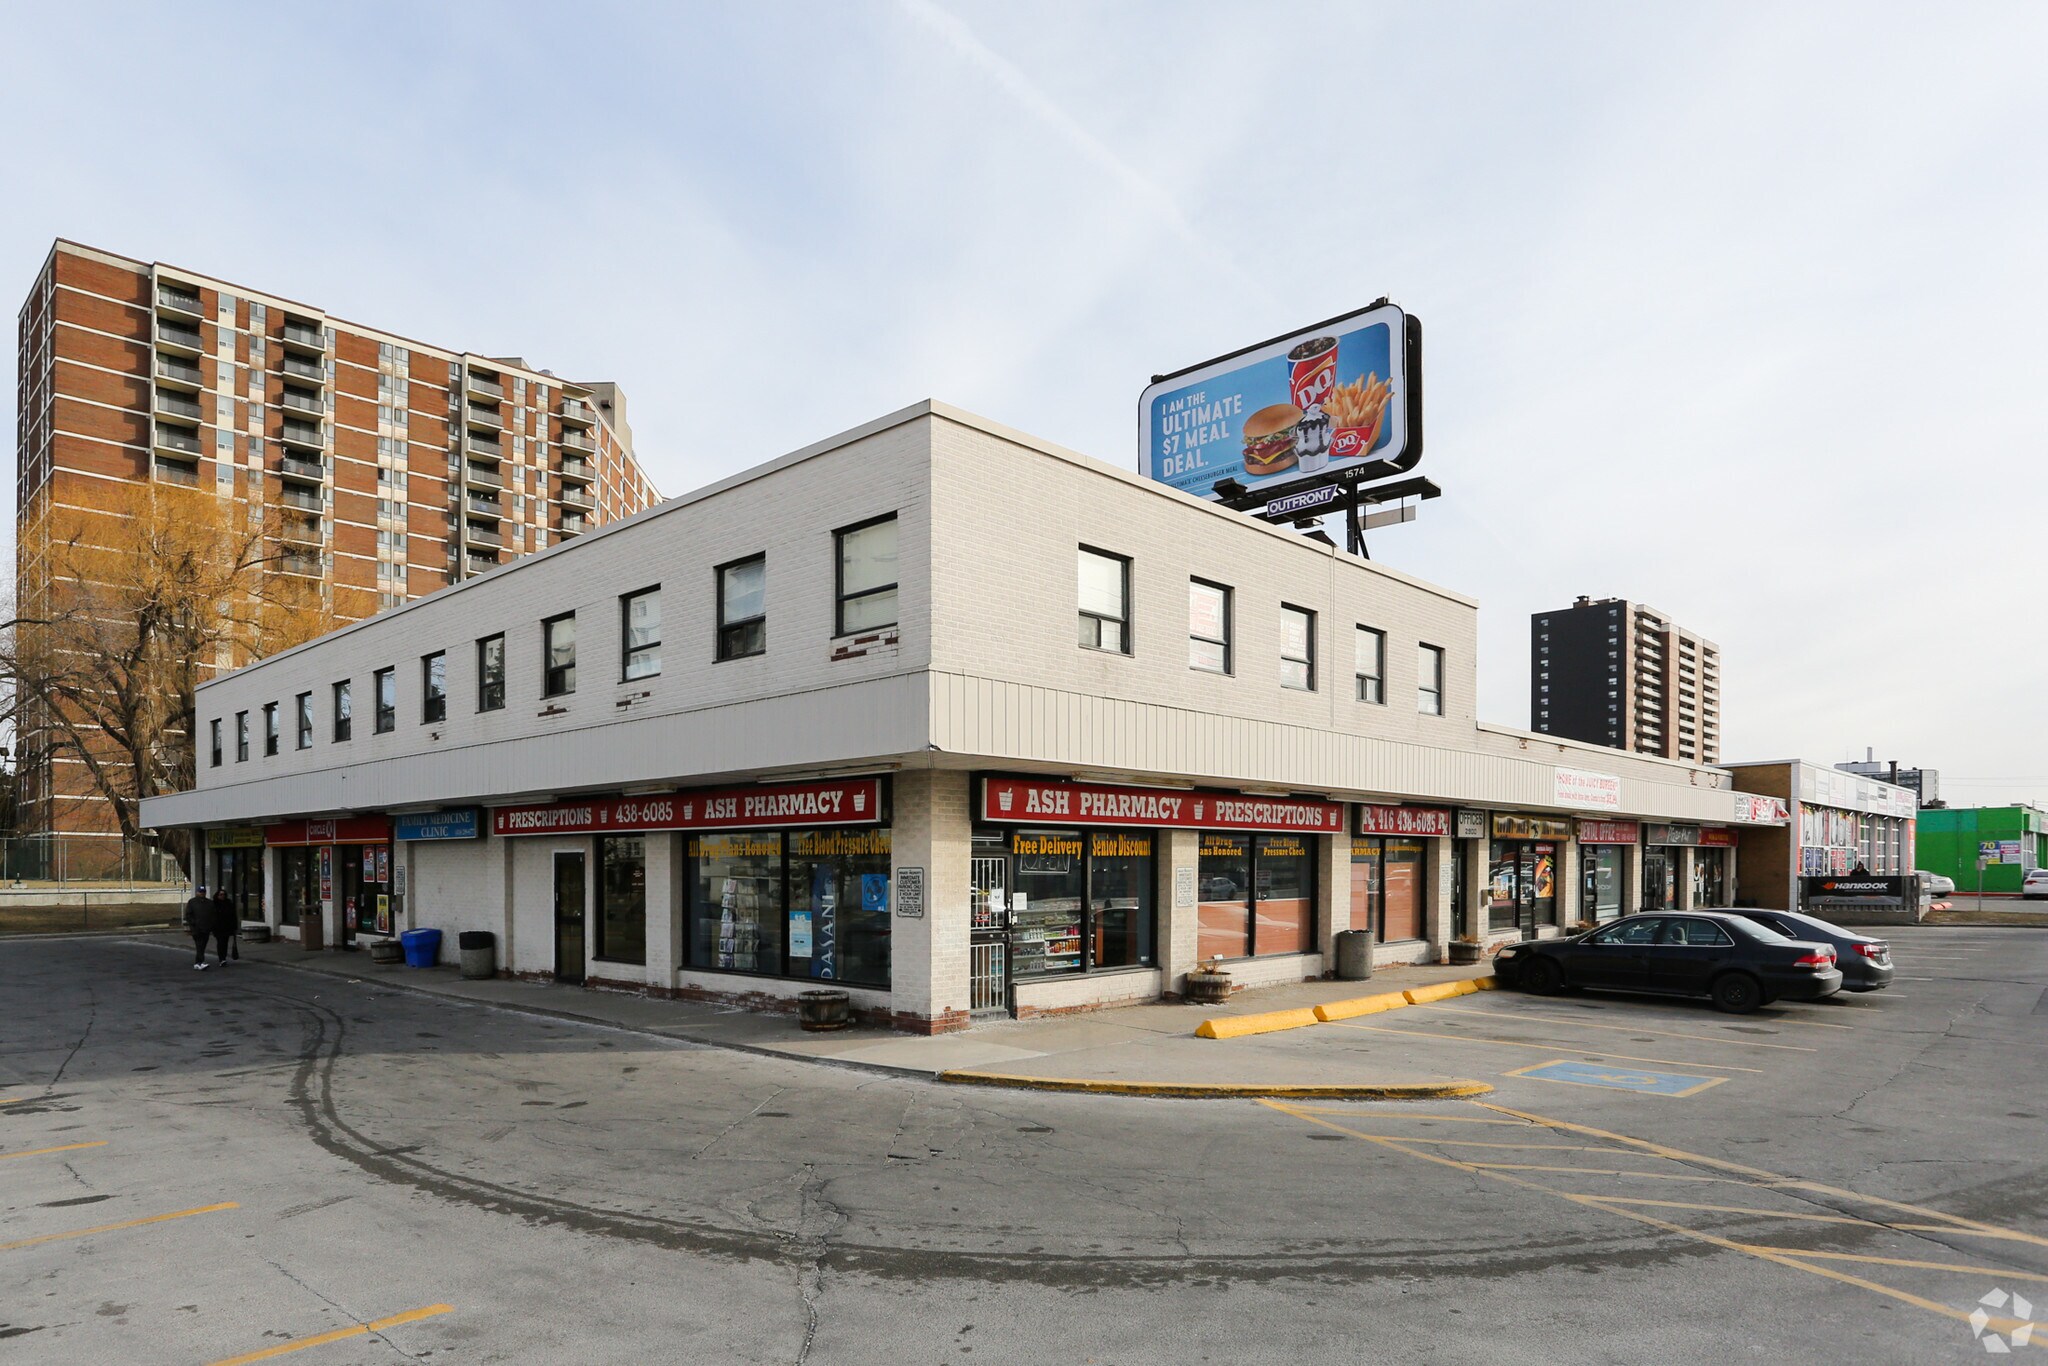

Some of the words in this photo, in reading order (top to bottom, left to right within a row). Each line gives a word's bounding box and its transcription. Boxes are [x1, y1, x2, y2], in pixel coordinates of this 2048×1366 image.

[1297, 369, 1333, 411] DQ
[1162, 404, 1167, 415] I
[1168, 400, 1184, 414] AM
[1187, 391, 1206, 407] THE
[1162, 394, 1242, 436] ULTIMATE
[1163, 435, 1181, 456] $7
[1185, 421, 1230, 449] MEAL
[1337, 432, 1359, 449] DQ
[1163, 453, 1209, 477] DEAL.
[1192, 469, 1225, 483] CHEESEBURGER
[1225, 465, 1238, 474] MEAL
[1344, 467, 1365, 479] 1574
[1269, 488, 1331, 514] OUTFRONT
[509, 807, 592, 828] PRESCRIPTIONS
[615, 802, 673, 823] 438-6085
[704, 798, 737, 819] ASH
[745, 790, 843, 817] PHARMACY
[1026, 789, 1070, 815] ASH
[1080, 792, 1182, 819] PHARMACY
[1216, 801, 1322, 826] PRESCRIPTIONS
[402, 816, 428, 827] FAMILY
[430, 811, 471, 825] MEDICINE
[1378, 809, 1394, 830] 416
[1397, 810, 1436, 833] 438-6085
[1459, 812, 1483, 826] OFFICES
[309, 824, 326, 837] CIRCLE
[421, 826, 449, 838] CLINIC
[1580, 821, 1598, 841] DENTAL
[1600, 822, 1616, 841] OFFICE
[688, 841, 699, 857] All
[699, 841, 719, 861] Drug
[720, 839, 743, 857] Plans
[744, 837, 781, 856] Honored
[798, 834, 814, 856] Free
[815, 831, 835, 855] Blood
[836, 830, 869, 855] Pressure
[1013, 834, 1038, 855] Free
[1040, 836, 1083, 860] Delivery
[1092, 834, 1117, 857] Senior
[1118, 834, 1151, 857] Discount
[1205, 836, 1215, 846] All
[1216, 837, 1232, 848] Drug
[1213, 847, 1242, 856] Honored
[1263, 847, 1288, 856] Pressure
[1289, 847, 1305, 856] Check
[1270, 837, 1282, 848] Free
[1283, 838, 1299, 848] Blood
[1354, 839, 1369, 847] ASH
[1981, 841, 1996, 850] 70
[820, 895, 834, 979] DASANI
